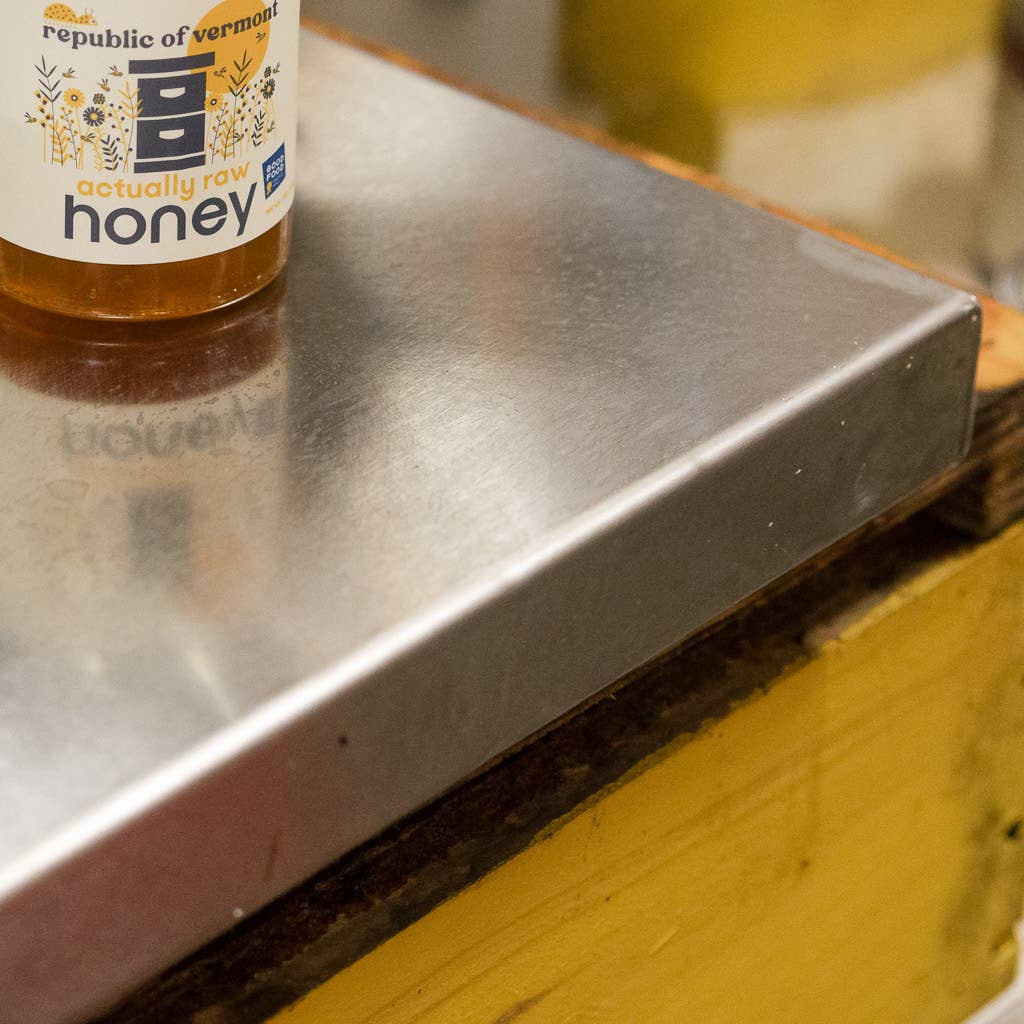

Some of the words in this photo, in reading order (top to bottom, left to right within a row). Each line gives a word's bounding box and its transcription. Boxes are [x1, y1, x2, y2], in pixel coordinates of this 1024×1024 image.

[43, 25, 154, 49] republic
[161, 25, 190, 47] of
[192, 0, 279, 43] vermont
[77, 173, 195, 202] actually
[203, 161, 250, 190] raw
[64, 182, 258, 245] honey
